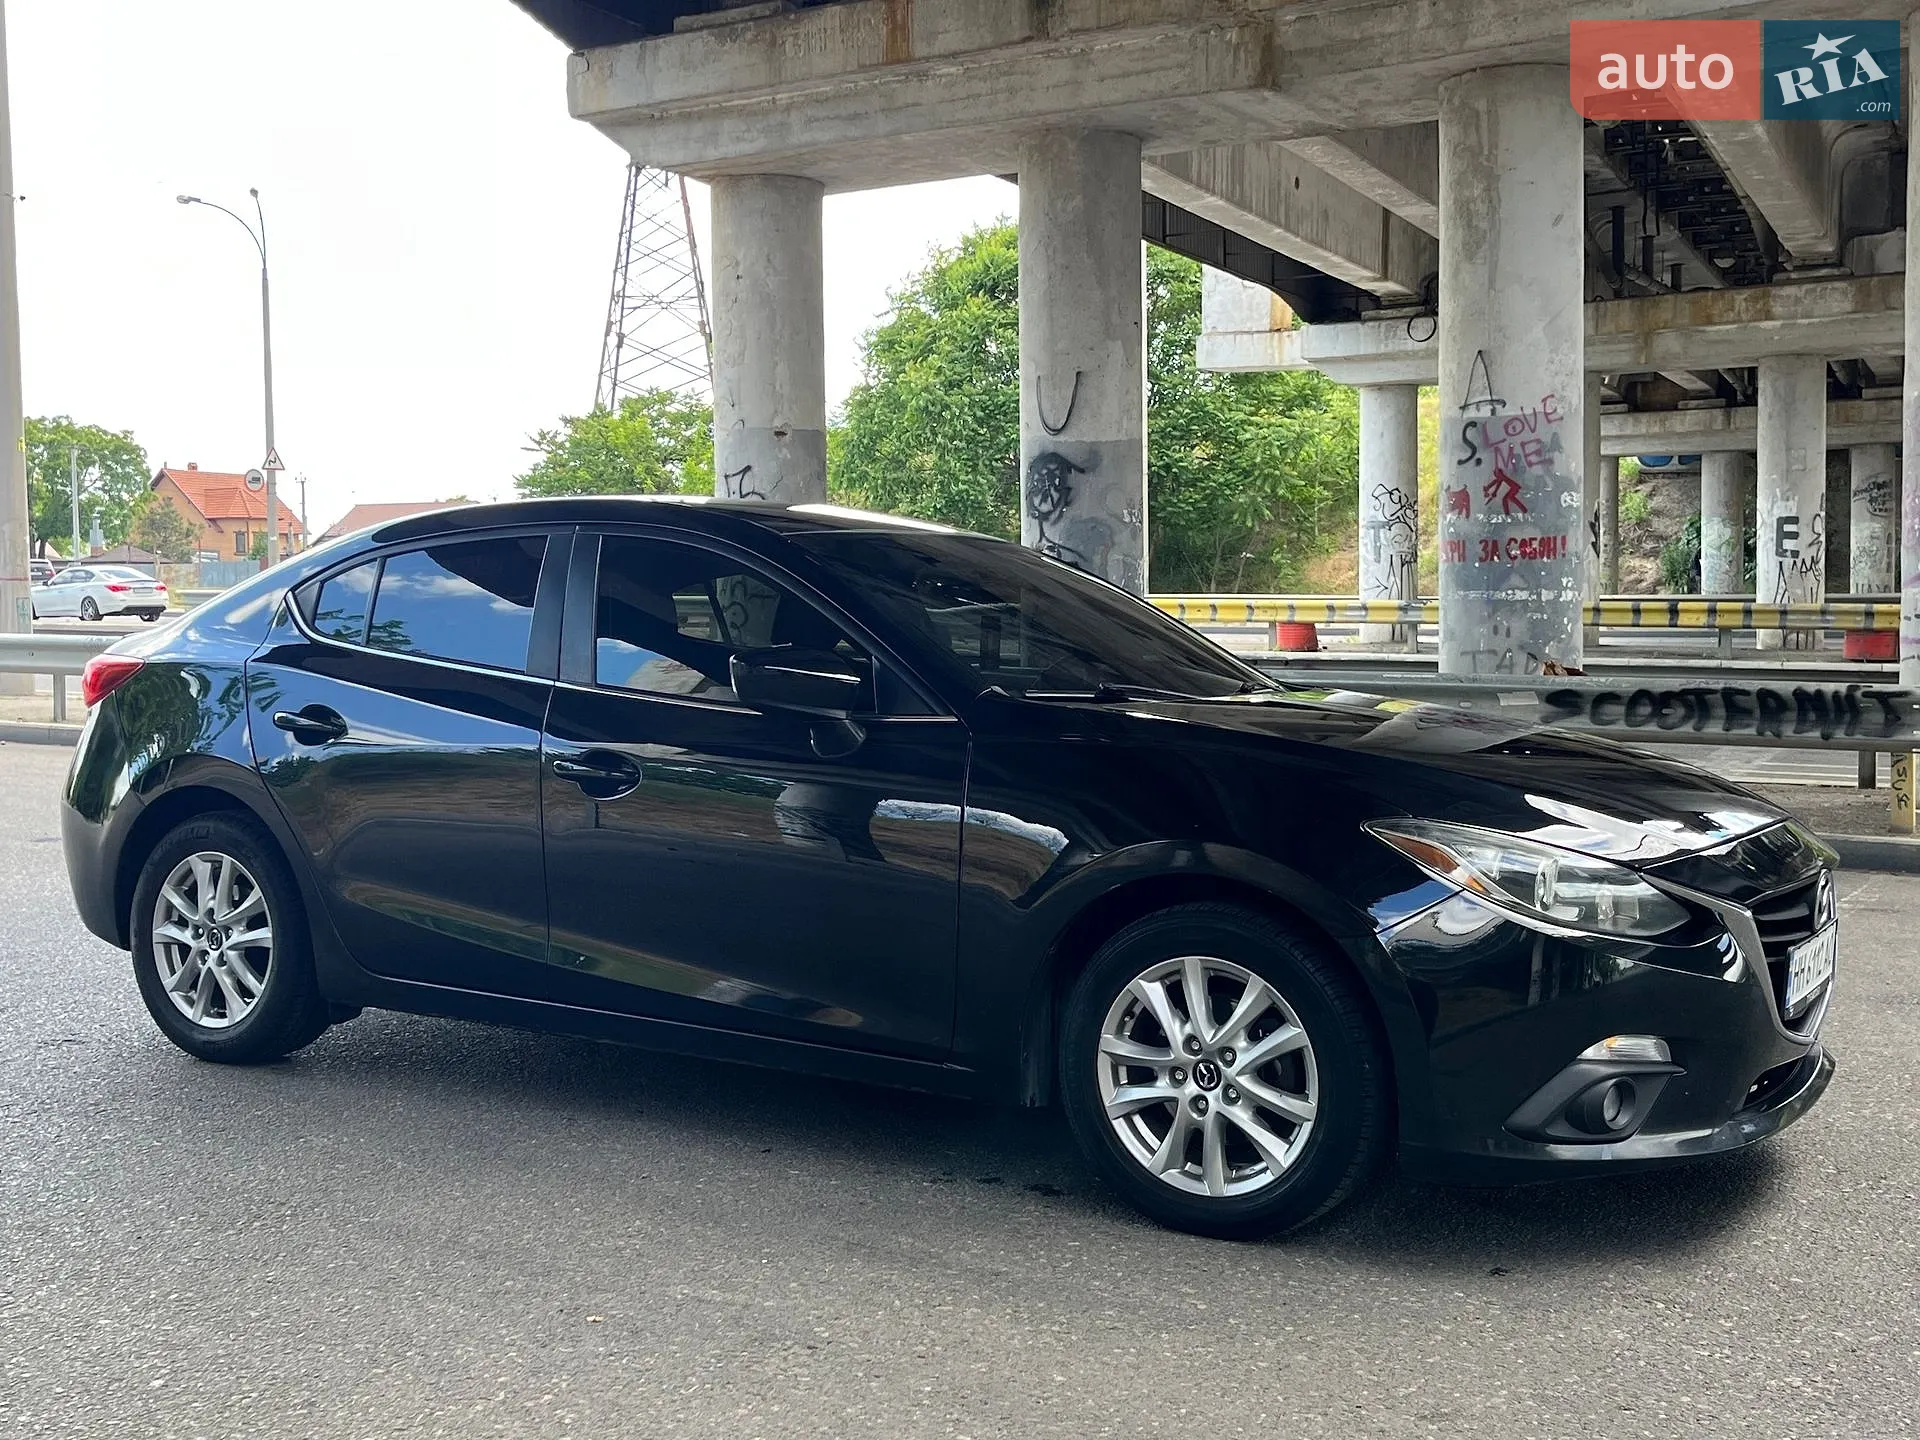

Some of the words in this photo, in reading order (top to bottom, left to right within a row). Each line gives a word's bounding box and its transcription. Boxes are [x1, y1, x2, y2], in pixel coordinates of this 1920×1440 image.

[1482, 393, 1565, 449] LOVE
[1494, 438, 1555, 473] ME
[1478, 538, 1501, 563] ЗА
[1775, 515, 1800, 559] E
